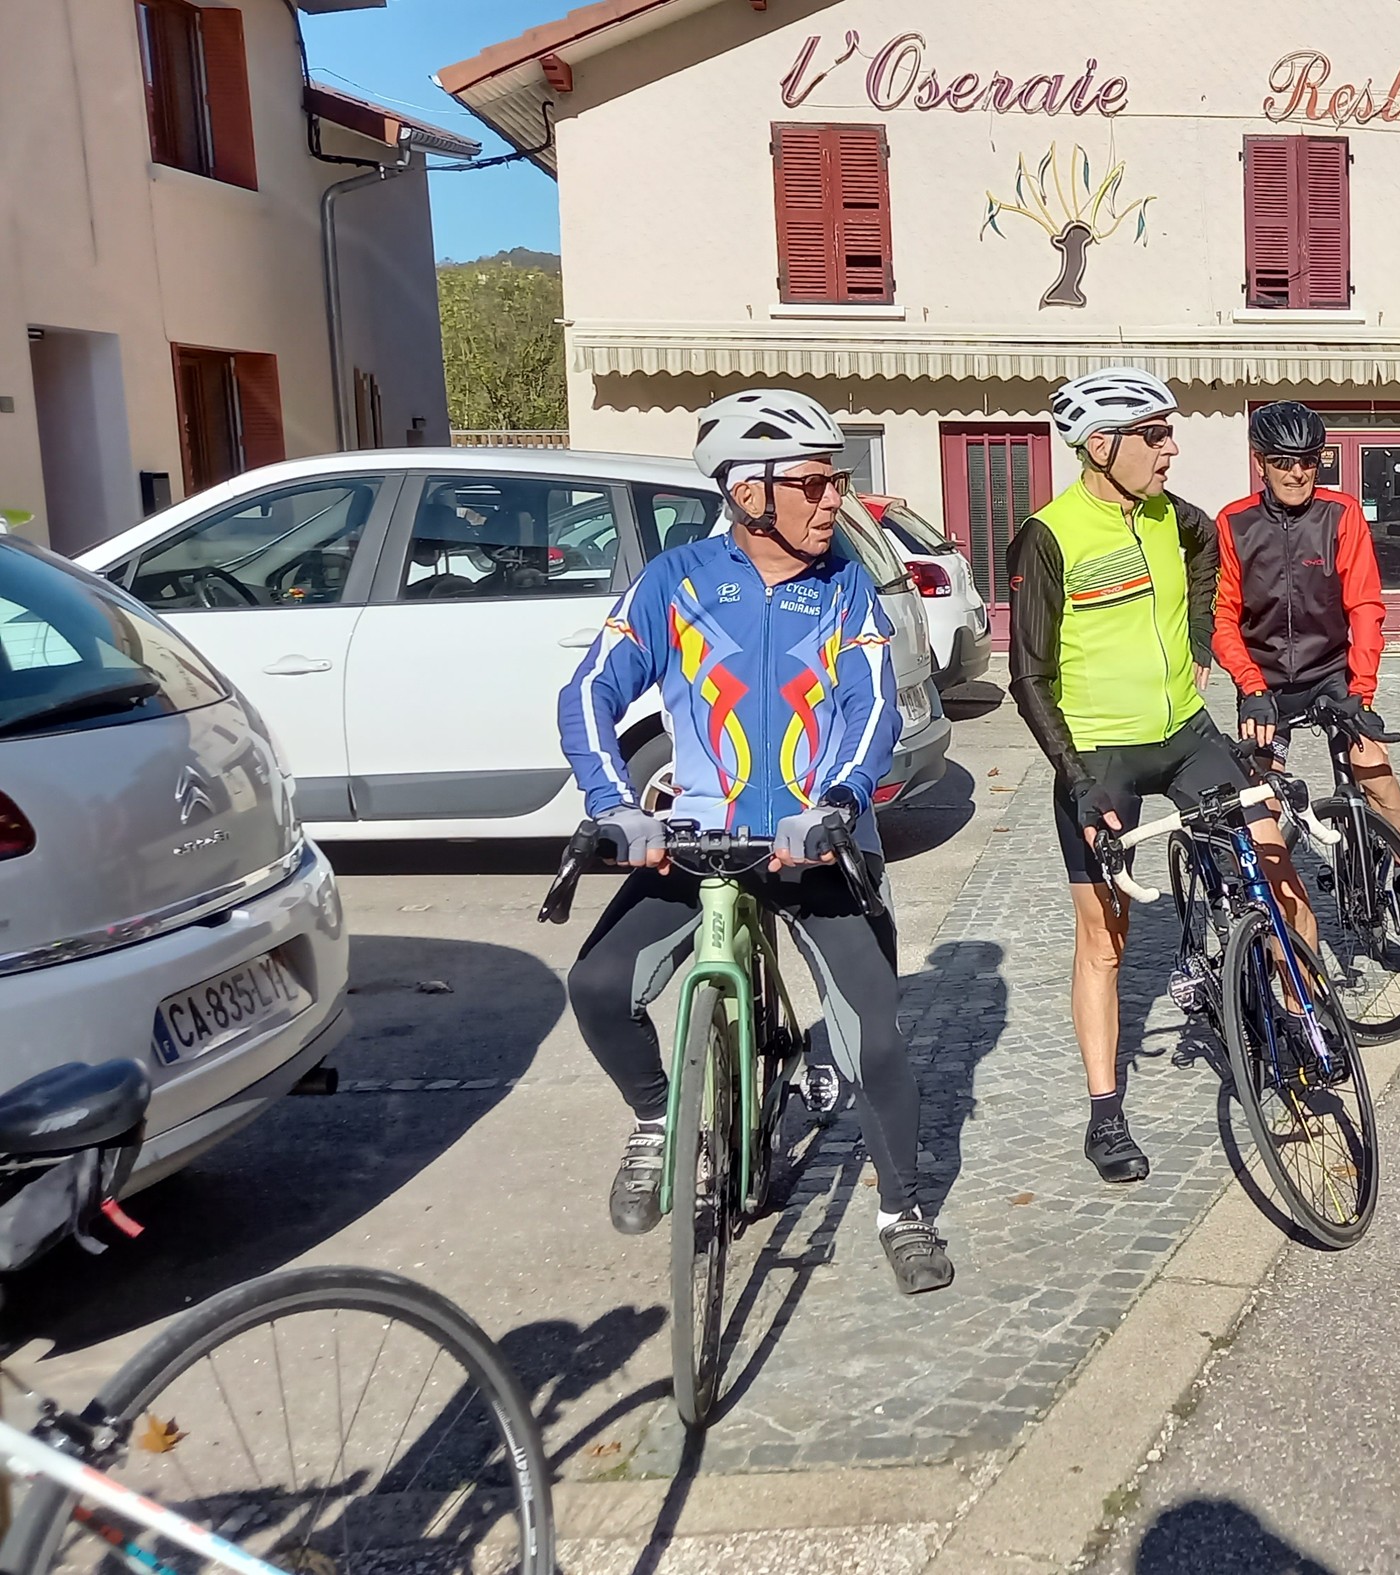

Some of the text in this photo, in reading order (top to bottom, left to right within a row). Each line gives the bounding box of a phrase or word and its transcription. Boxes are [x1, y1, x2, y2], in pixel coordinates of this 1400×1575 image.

[786, 582, 819, 600] CYCLOS
[780, 600, 821, 616] MOIRANS
[711, 910, 725, 949] KTM
